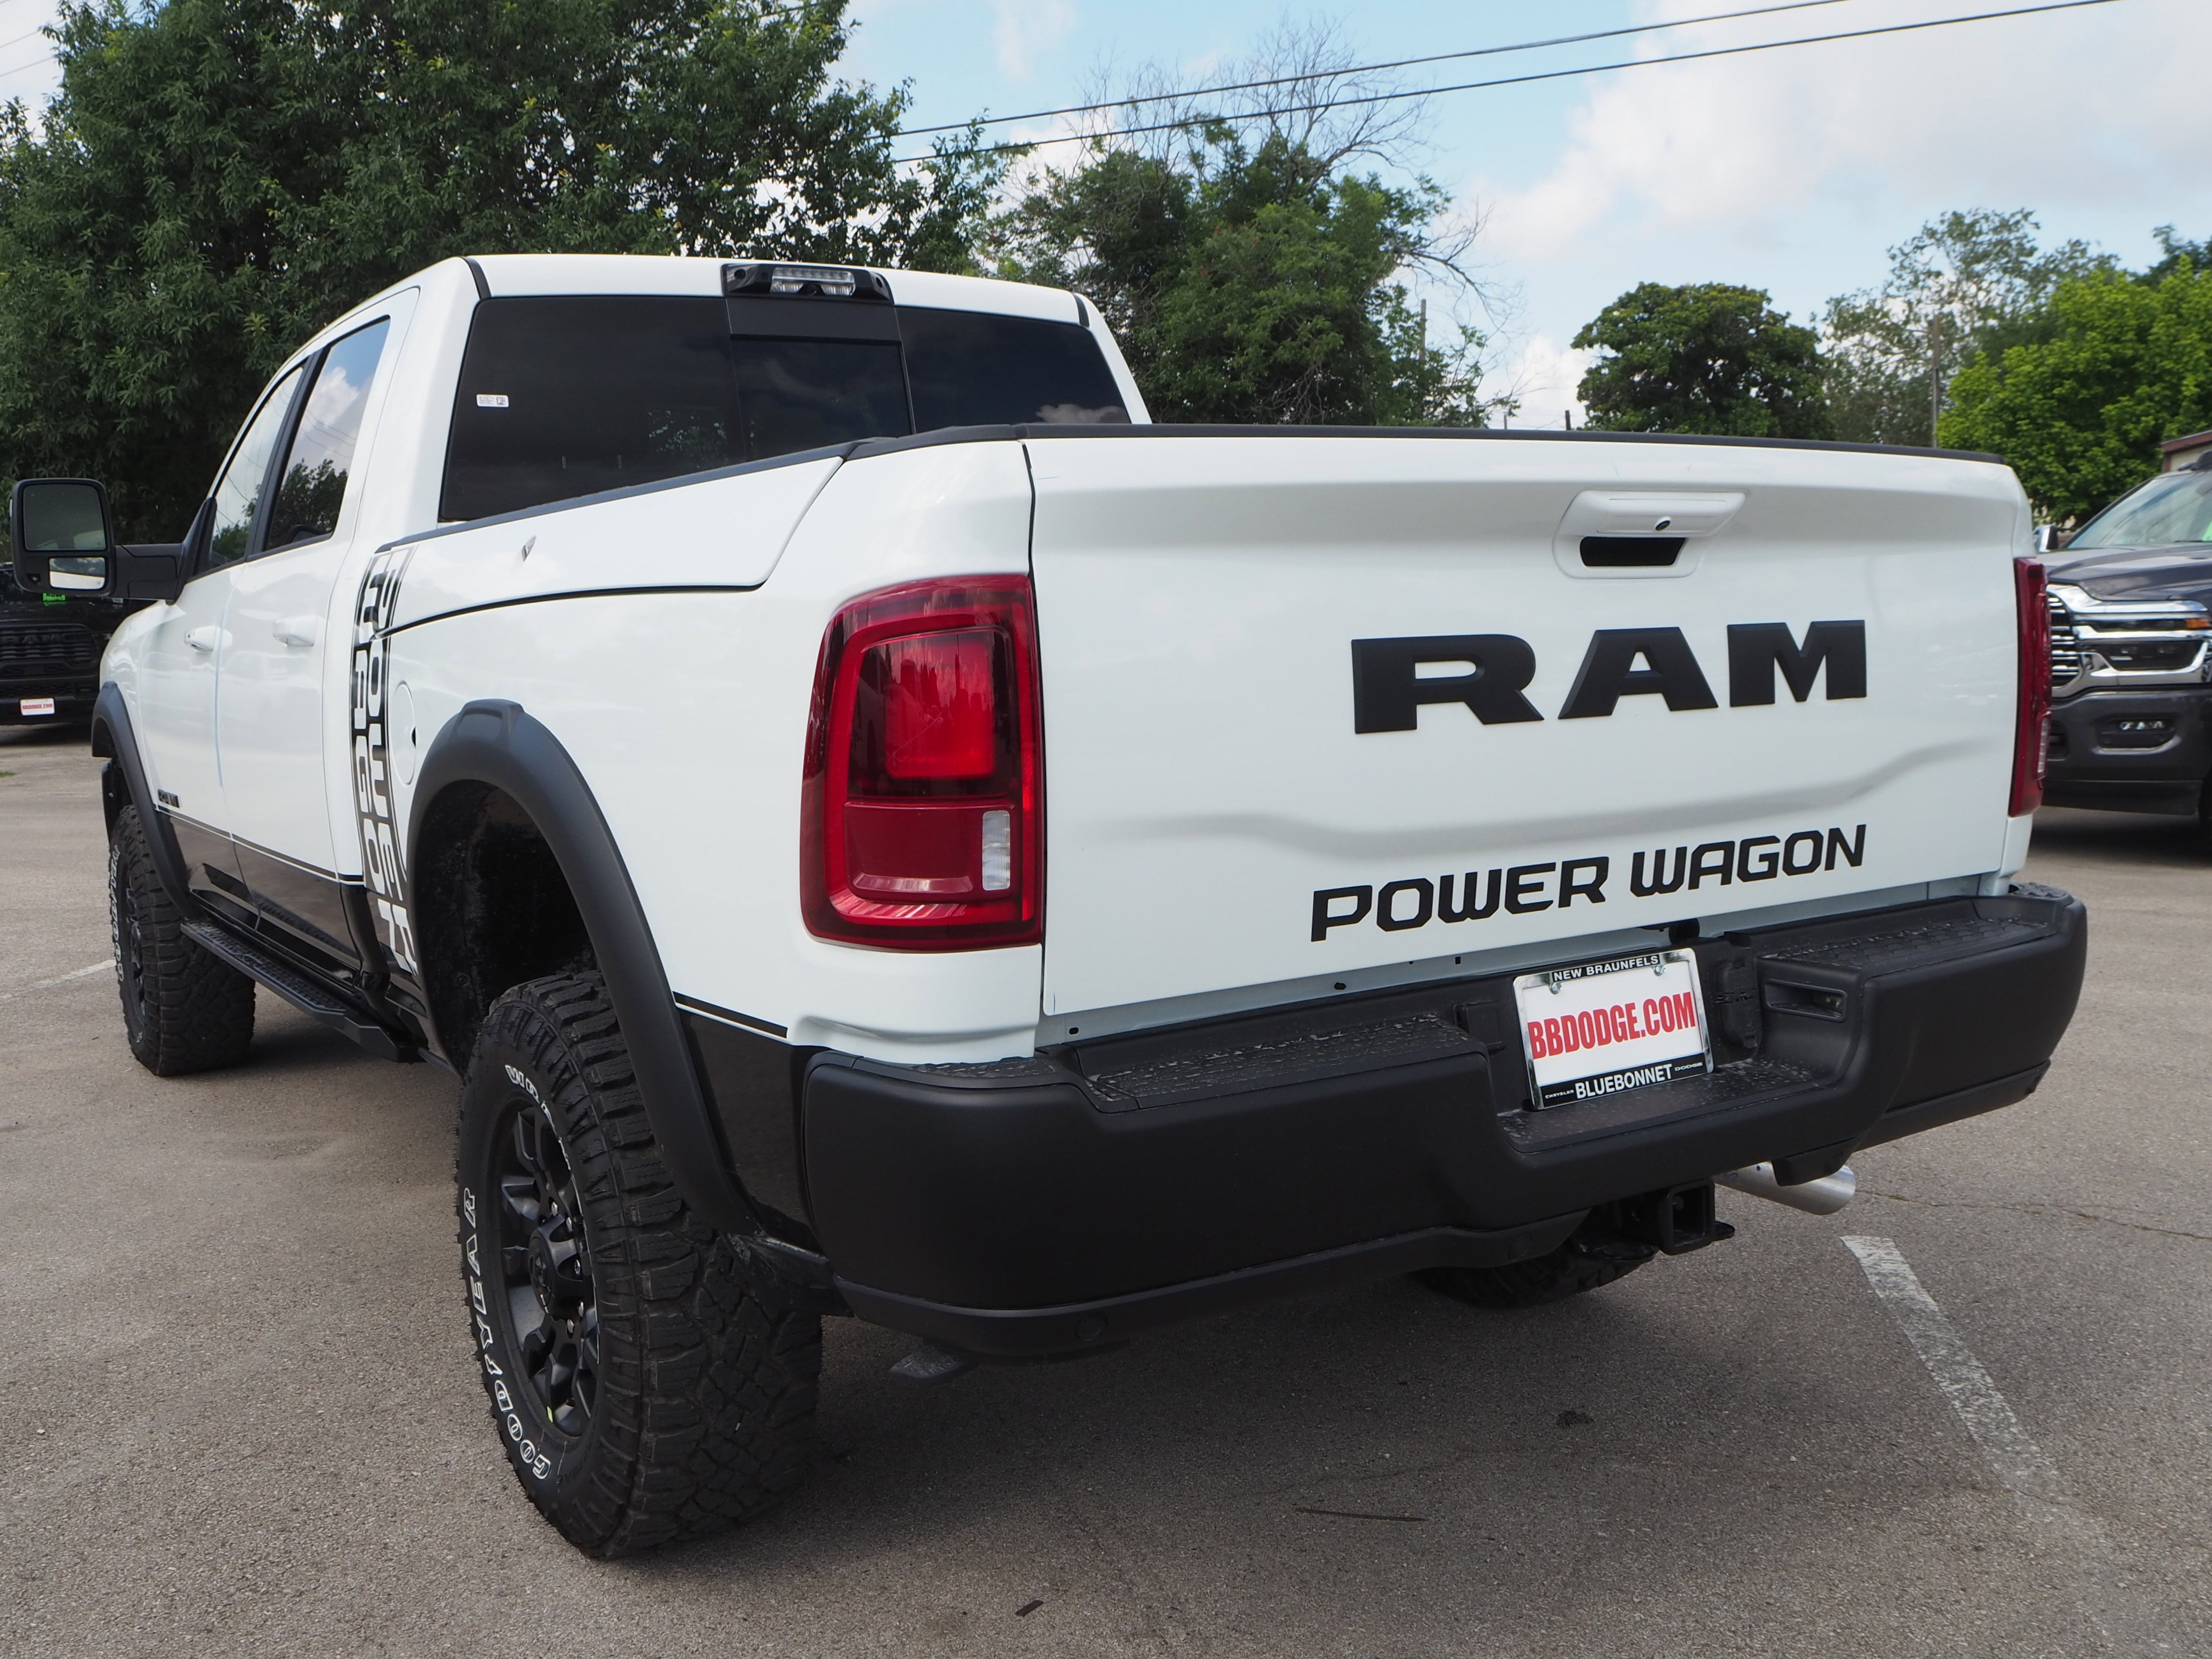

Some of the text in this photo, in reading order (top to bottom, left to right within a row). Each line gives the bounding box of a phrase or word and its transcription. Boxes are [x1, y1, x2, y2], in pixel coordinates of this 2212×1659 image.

[1351, 619, 1867, 734] RAM
[354, 554, 412, 974] WAGON
[368, 548, 418, 976] POWER
[1311, 824, 1866, 942] POWER WAGON
[1528, 992, 1696, 1059] BBDODGE.COM
[1554, 955, 1659, 982] NEW BRAUNFELS
[1575, 1064, 1672, 1100] BLUEBONNET
[1674, 1062, 1703, 1071] DODGE
[464, 1187, 552, 1481] GOODYEAR
